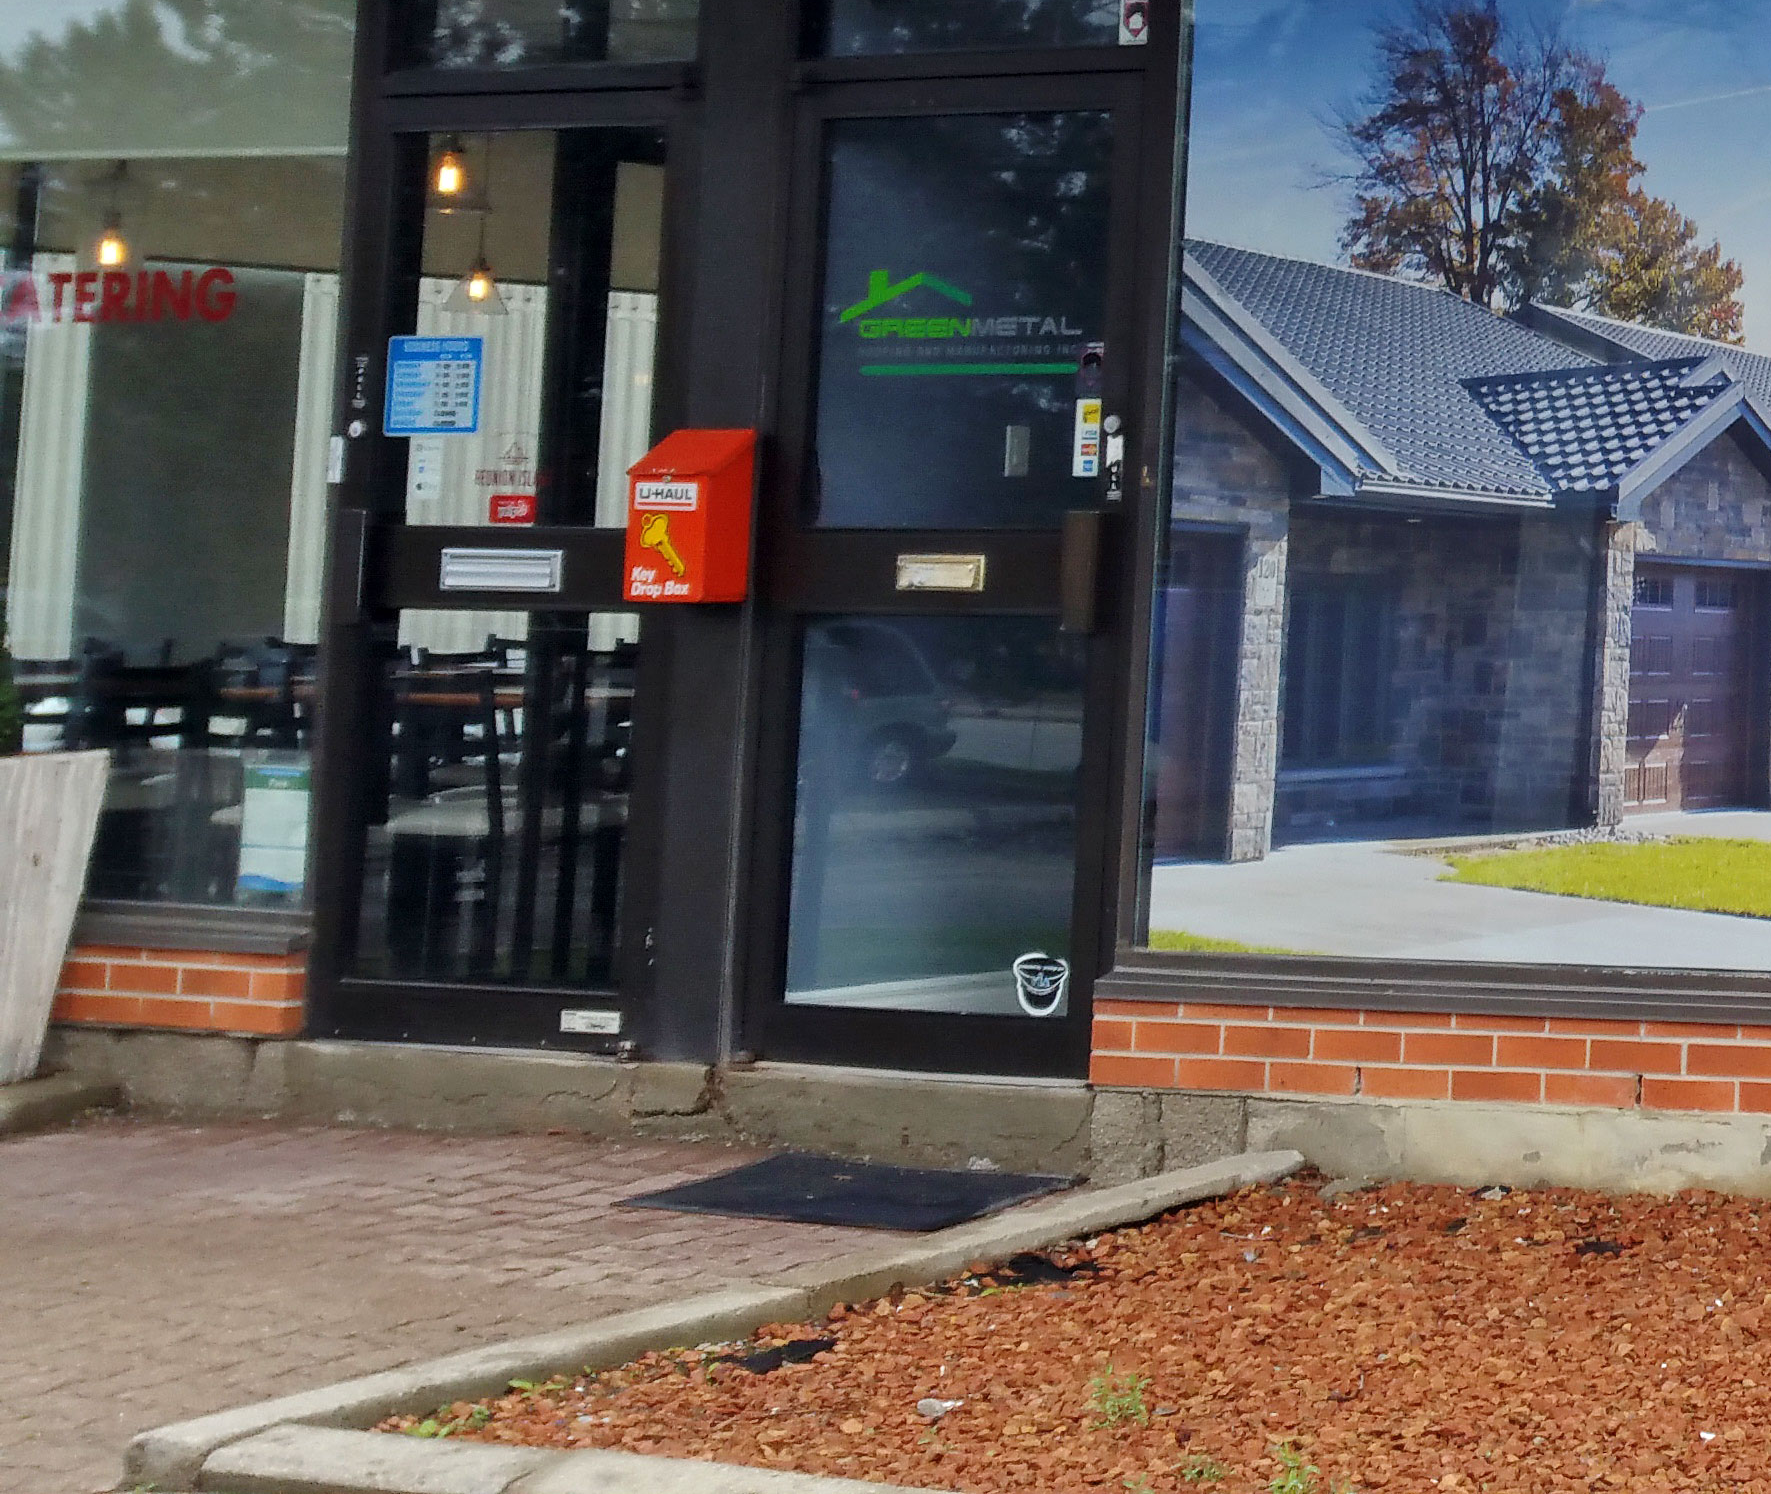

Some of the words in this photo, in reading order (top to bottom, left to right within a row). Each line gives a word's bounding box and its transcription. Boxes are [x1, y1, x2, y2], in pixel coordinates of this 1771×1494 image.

[0, 267, 237, 323] ATERING
[858, 316, 1083, 339] GREENMETAL
[639, 488, 692, 500] U-HAUL
[631, 566, 656, 582] Key
[631, 581, 662, 598] Drop
[664, 579, 689, 595] Box
